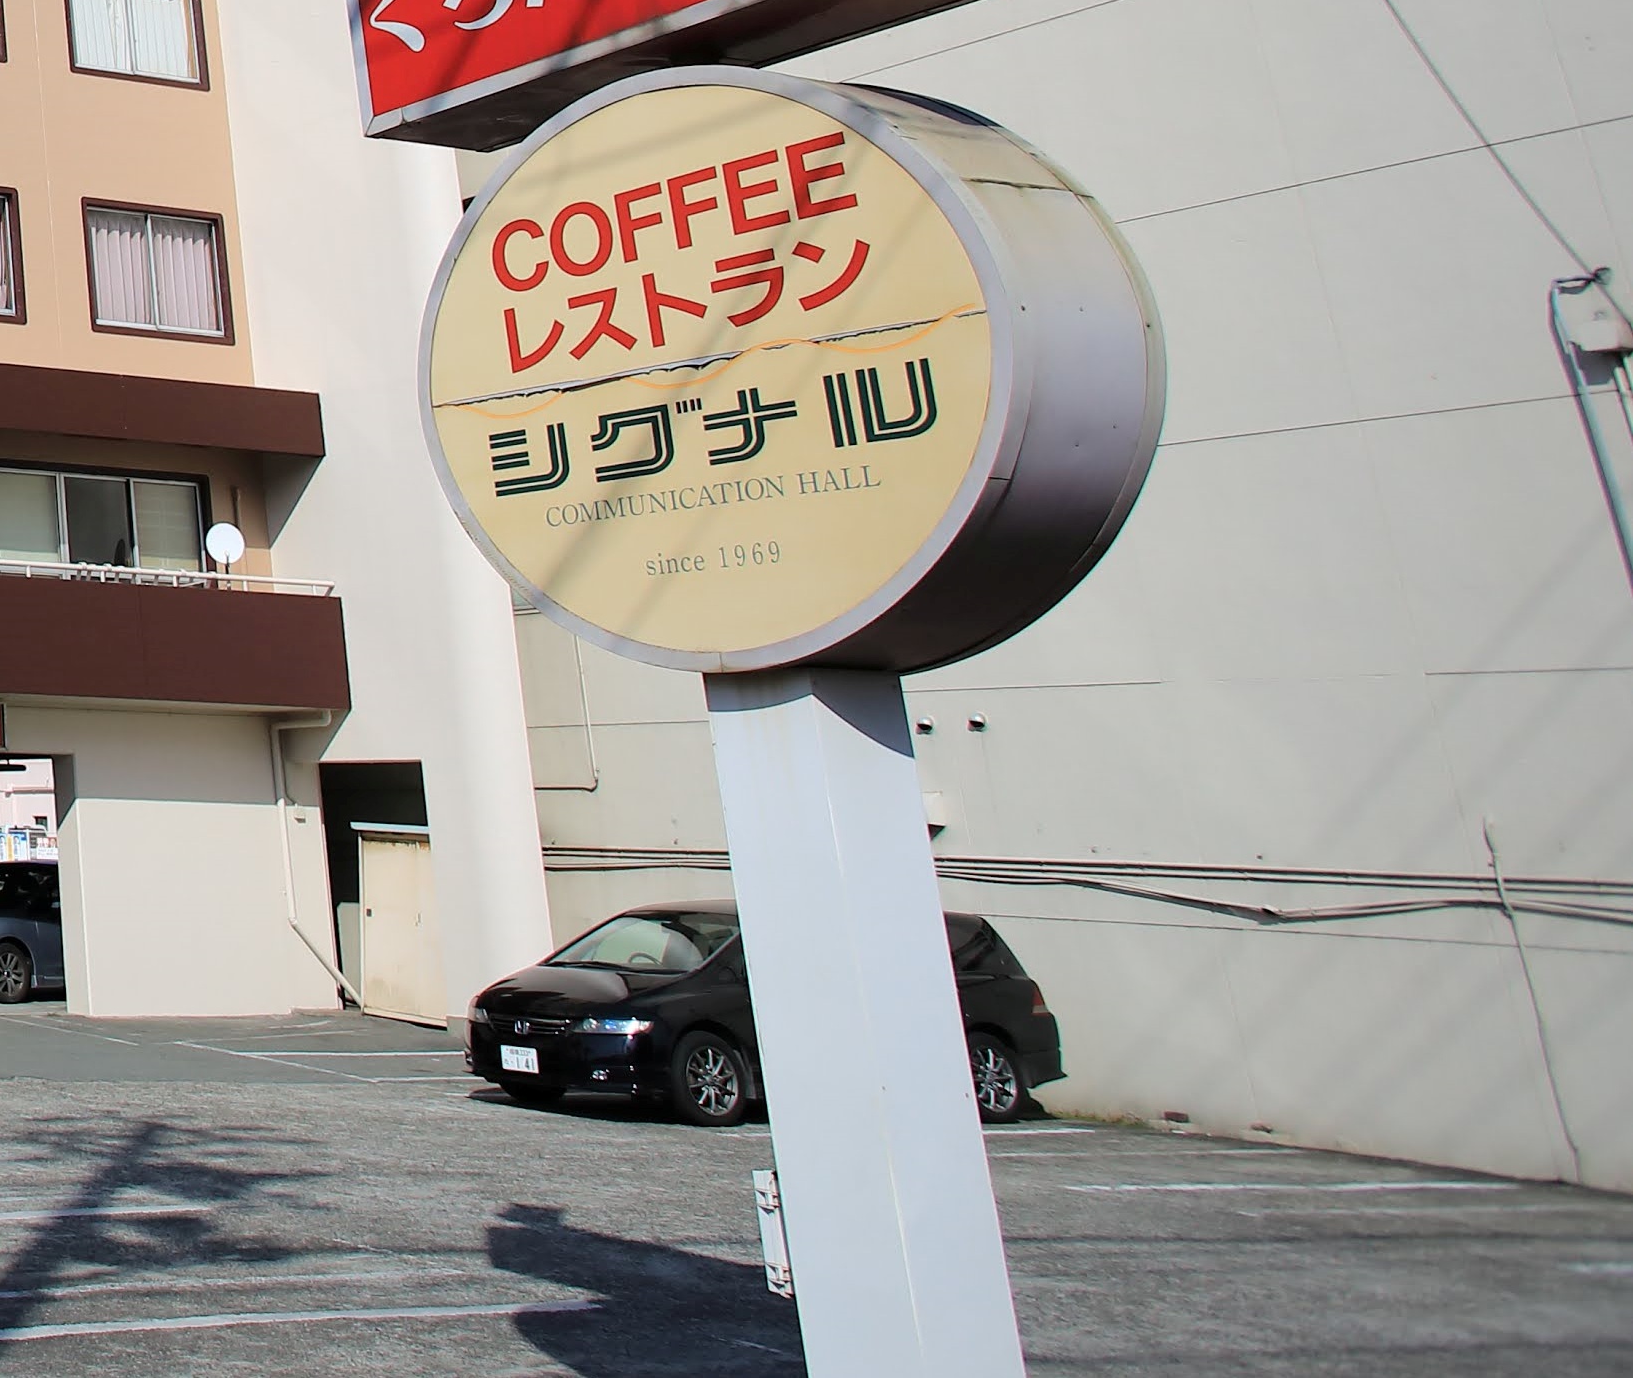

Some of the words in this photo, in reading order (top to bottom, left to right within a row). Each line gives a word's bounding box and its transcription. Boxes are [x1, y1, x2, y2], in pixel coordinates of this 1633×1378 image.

[491, 131, 859, 293] COFFEE
[503, 238, 871, 375] レストラン
[488, 357, 939, 498] シグナル
[544, 475, 785, 529] COMMUNICATION
[798, 464, 882, 496] HALL
[644, 551, 706, 578] since
[718, 540, 783, 569] 1969
